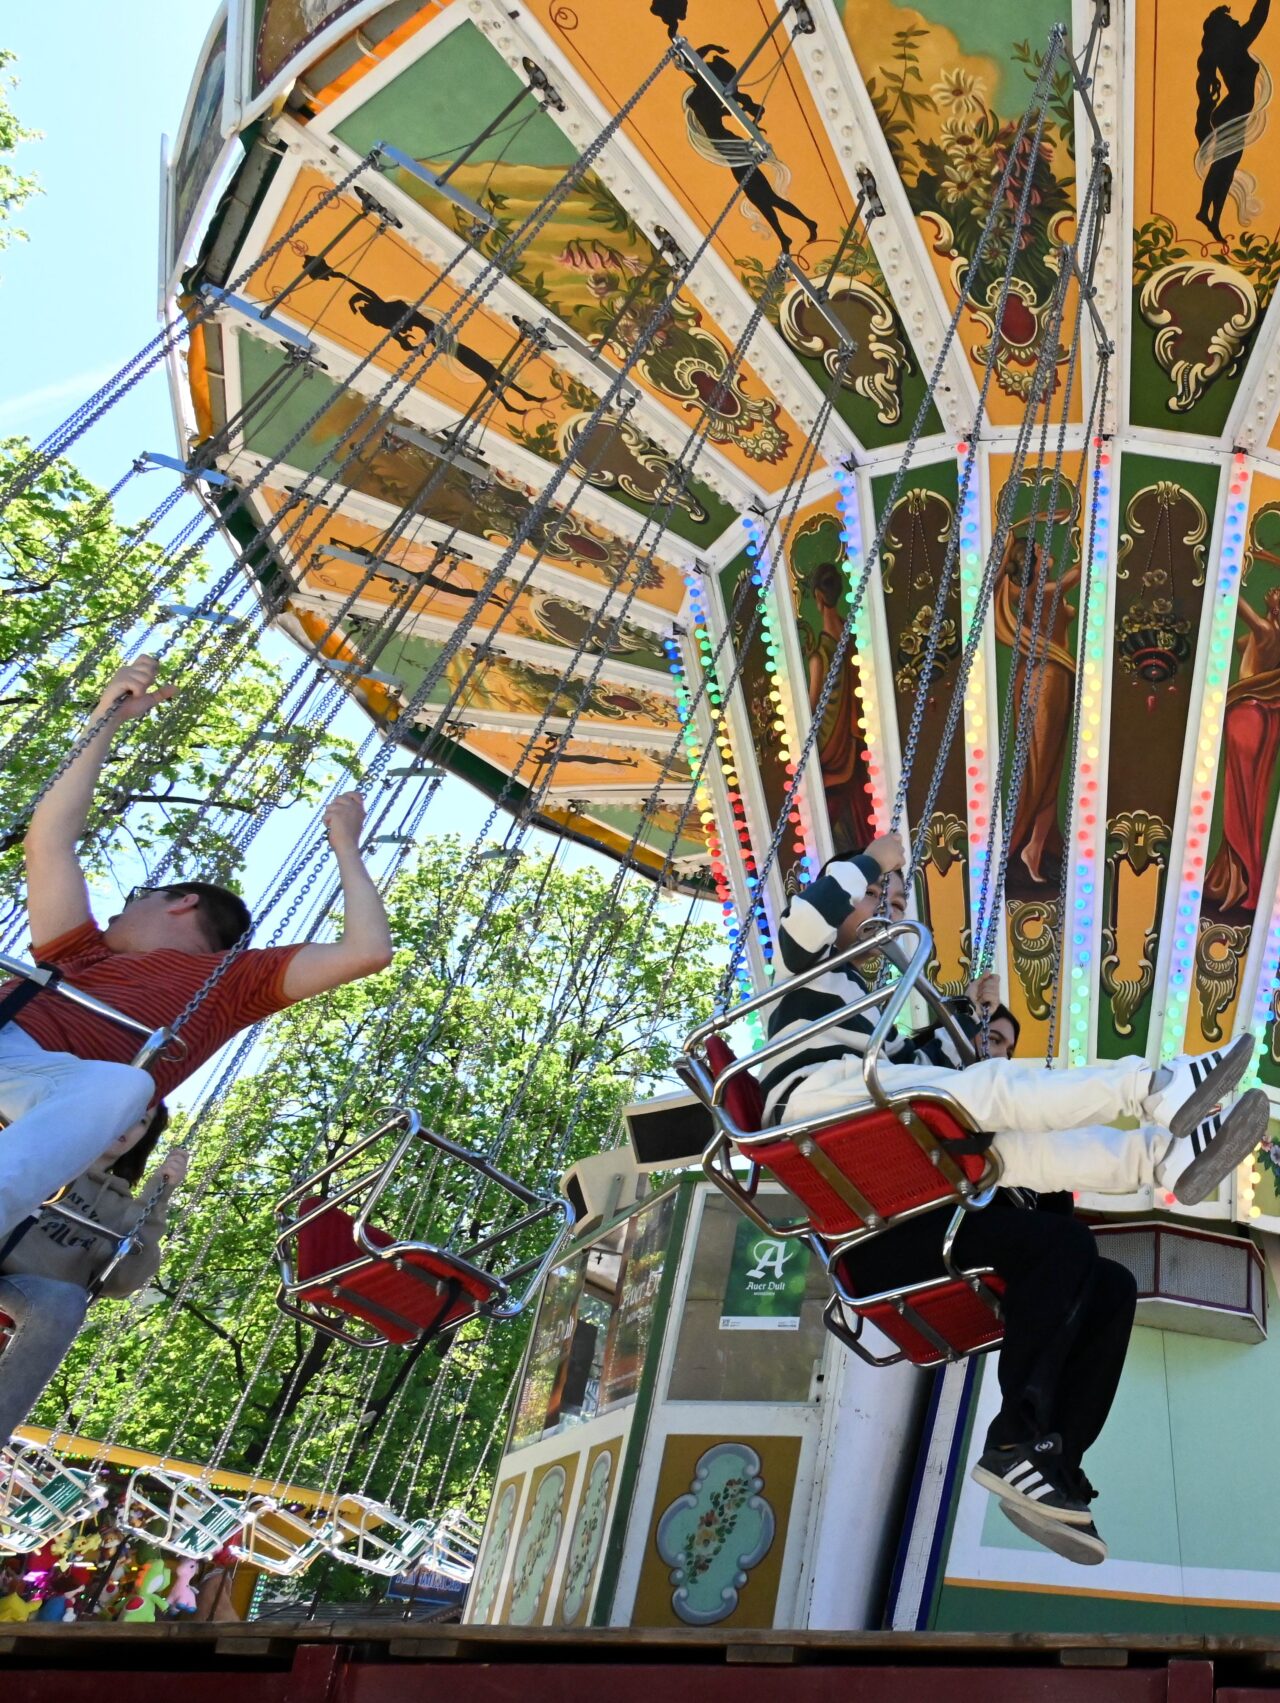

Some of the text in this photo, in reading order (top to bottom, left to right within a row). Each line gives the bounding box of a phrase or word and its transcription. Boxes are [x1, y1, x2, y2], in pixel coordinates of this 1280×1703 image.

[746, 1239, 794, 1280] A
[745, 1281, 786, 1291] Auer Dult
